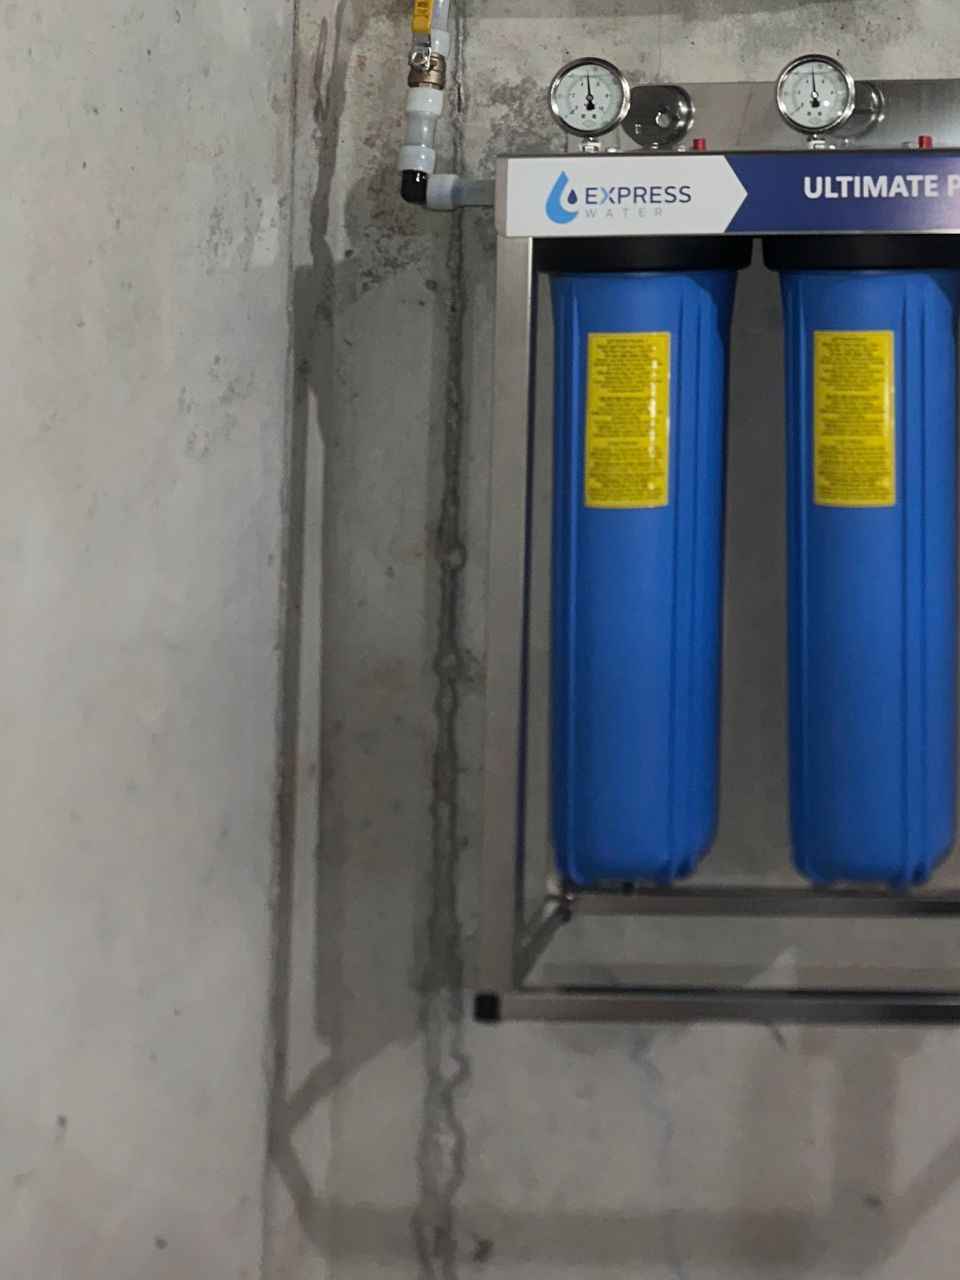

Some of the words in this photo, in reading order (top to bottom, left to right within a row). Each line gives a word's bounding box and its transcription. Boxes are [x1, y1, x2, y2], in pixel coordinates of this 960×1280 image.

[585, 185, 692, 205] EXPRESS
[803, 174, 939, 199] ULTIMATE
[585, 207, 664, 218] WATER
